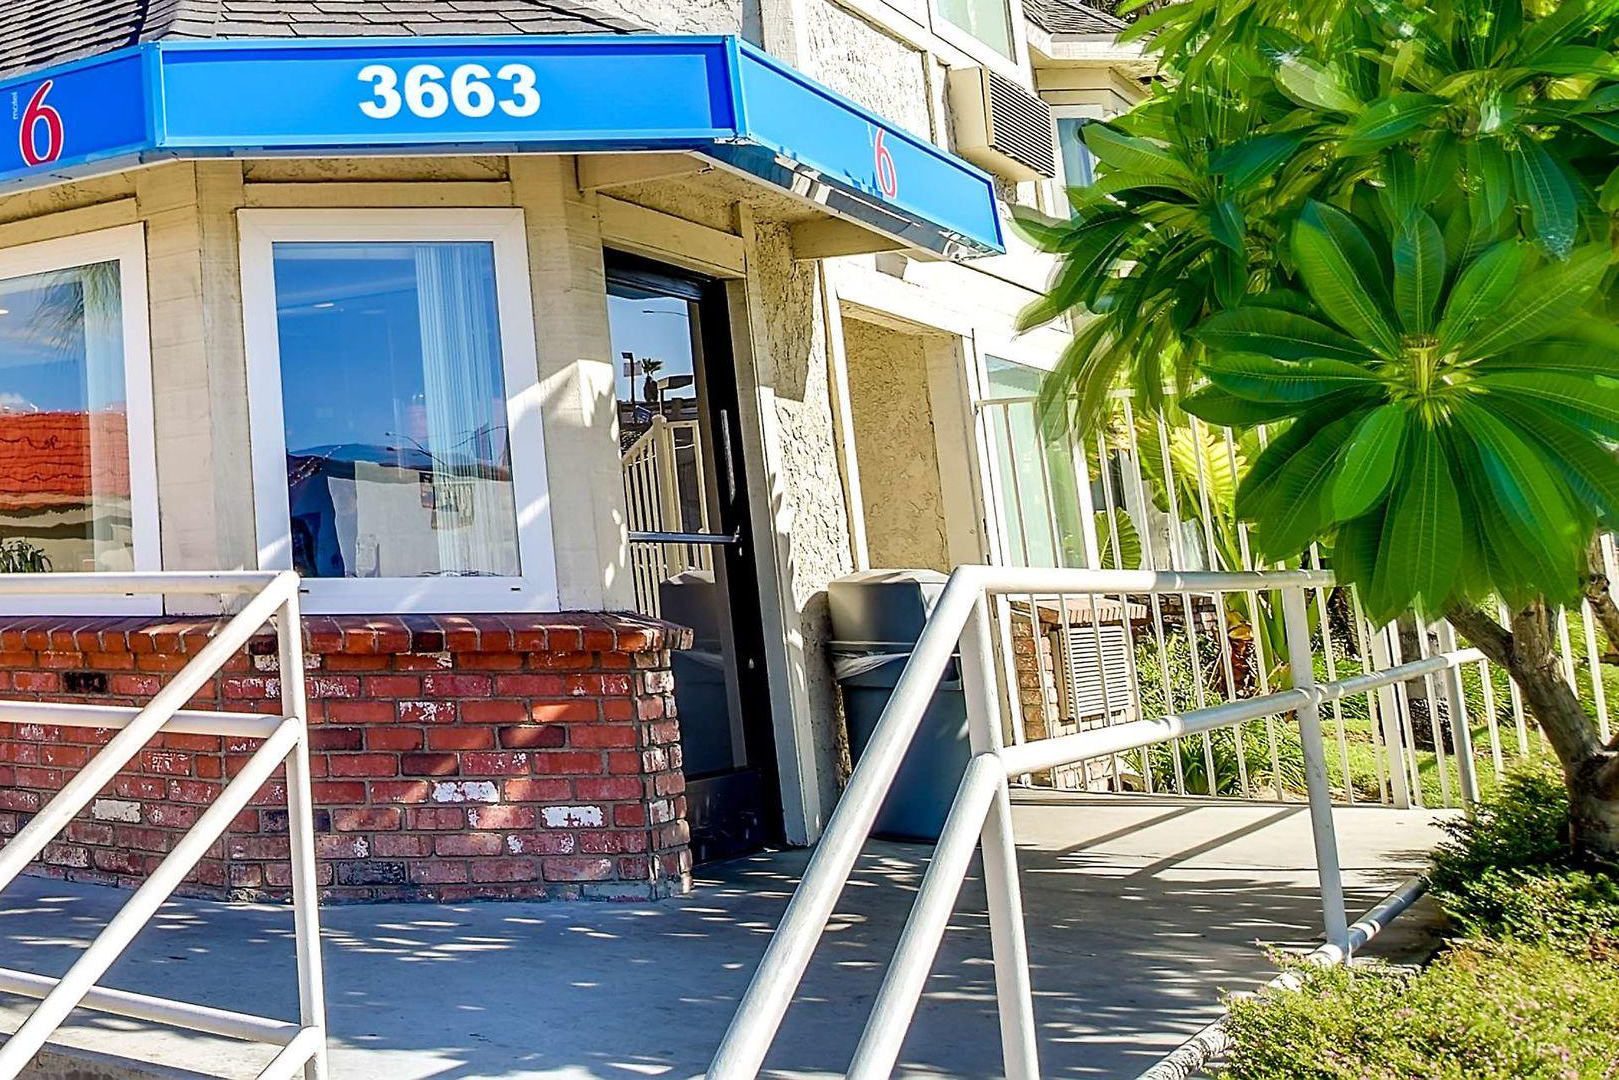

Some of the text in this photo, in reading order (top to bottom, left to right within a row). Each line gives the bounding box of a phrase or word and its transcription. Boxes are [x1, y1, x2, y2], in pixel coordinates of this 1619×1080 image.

[10, 79, 64, 168] motel 6
[357, 63, 541, 119] 3663
[875, 127, 898, 199] 6
